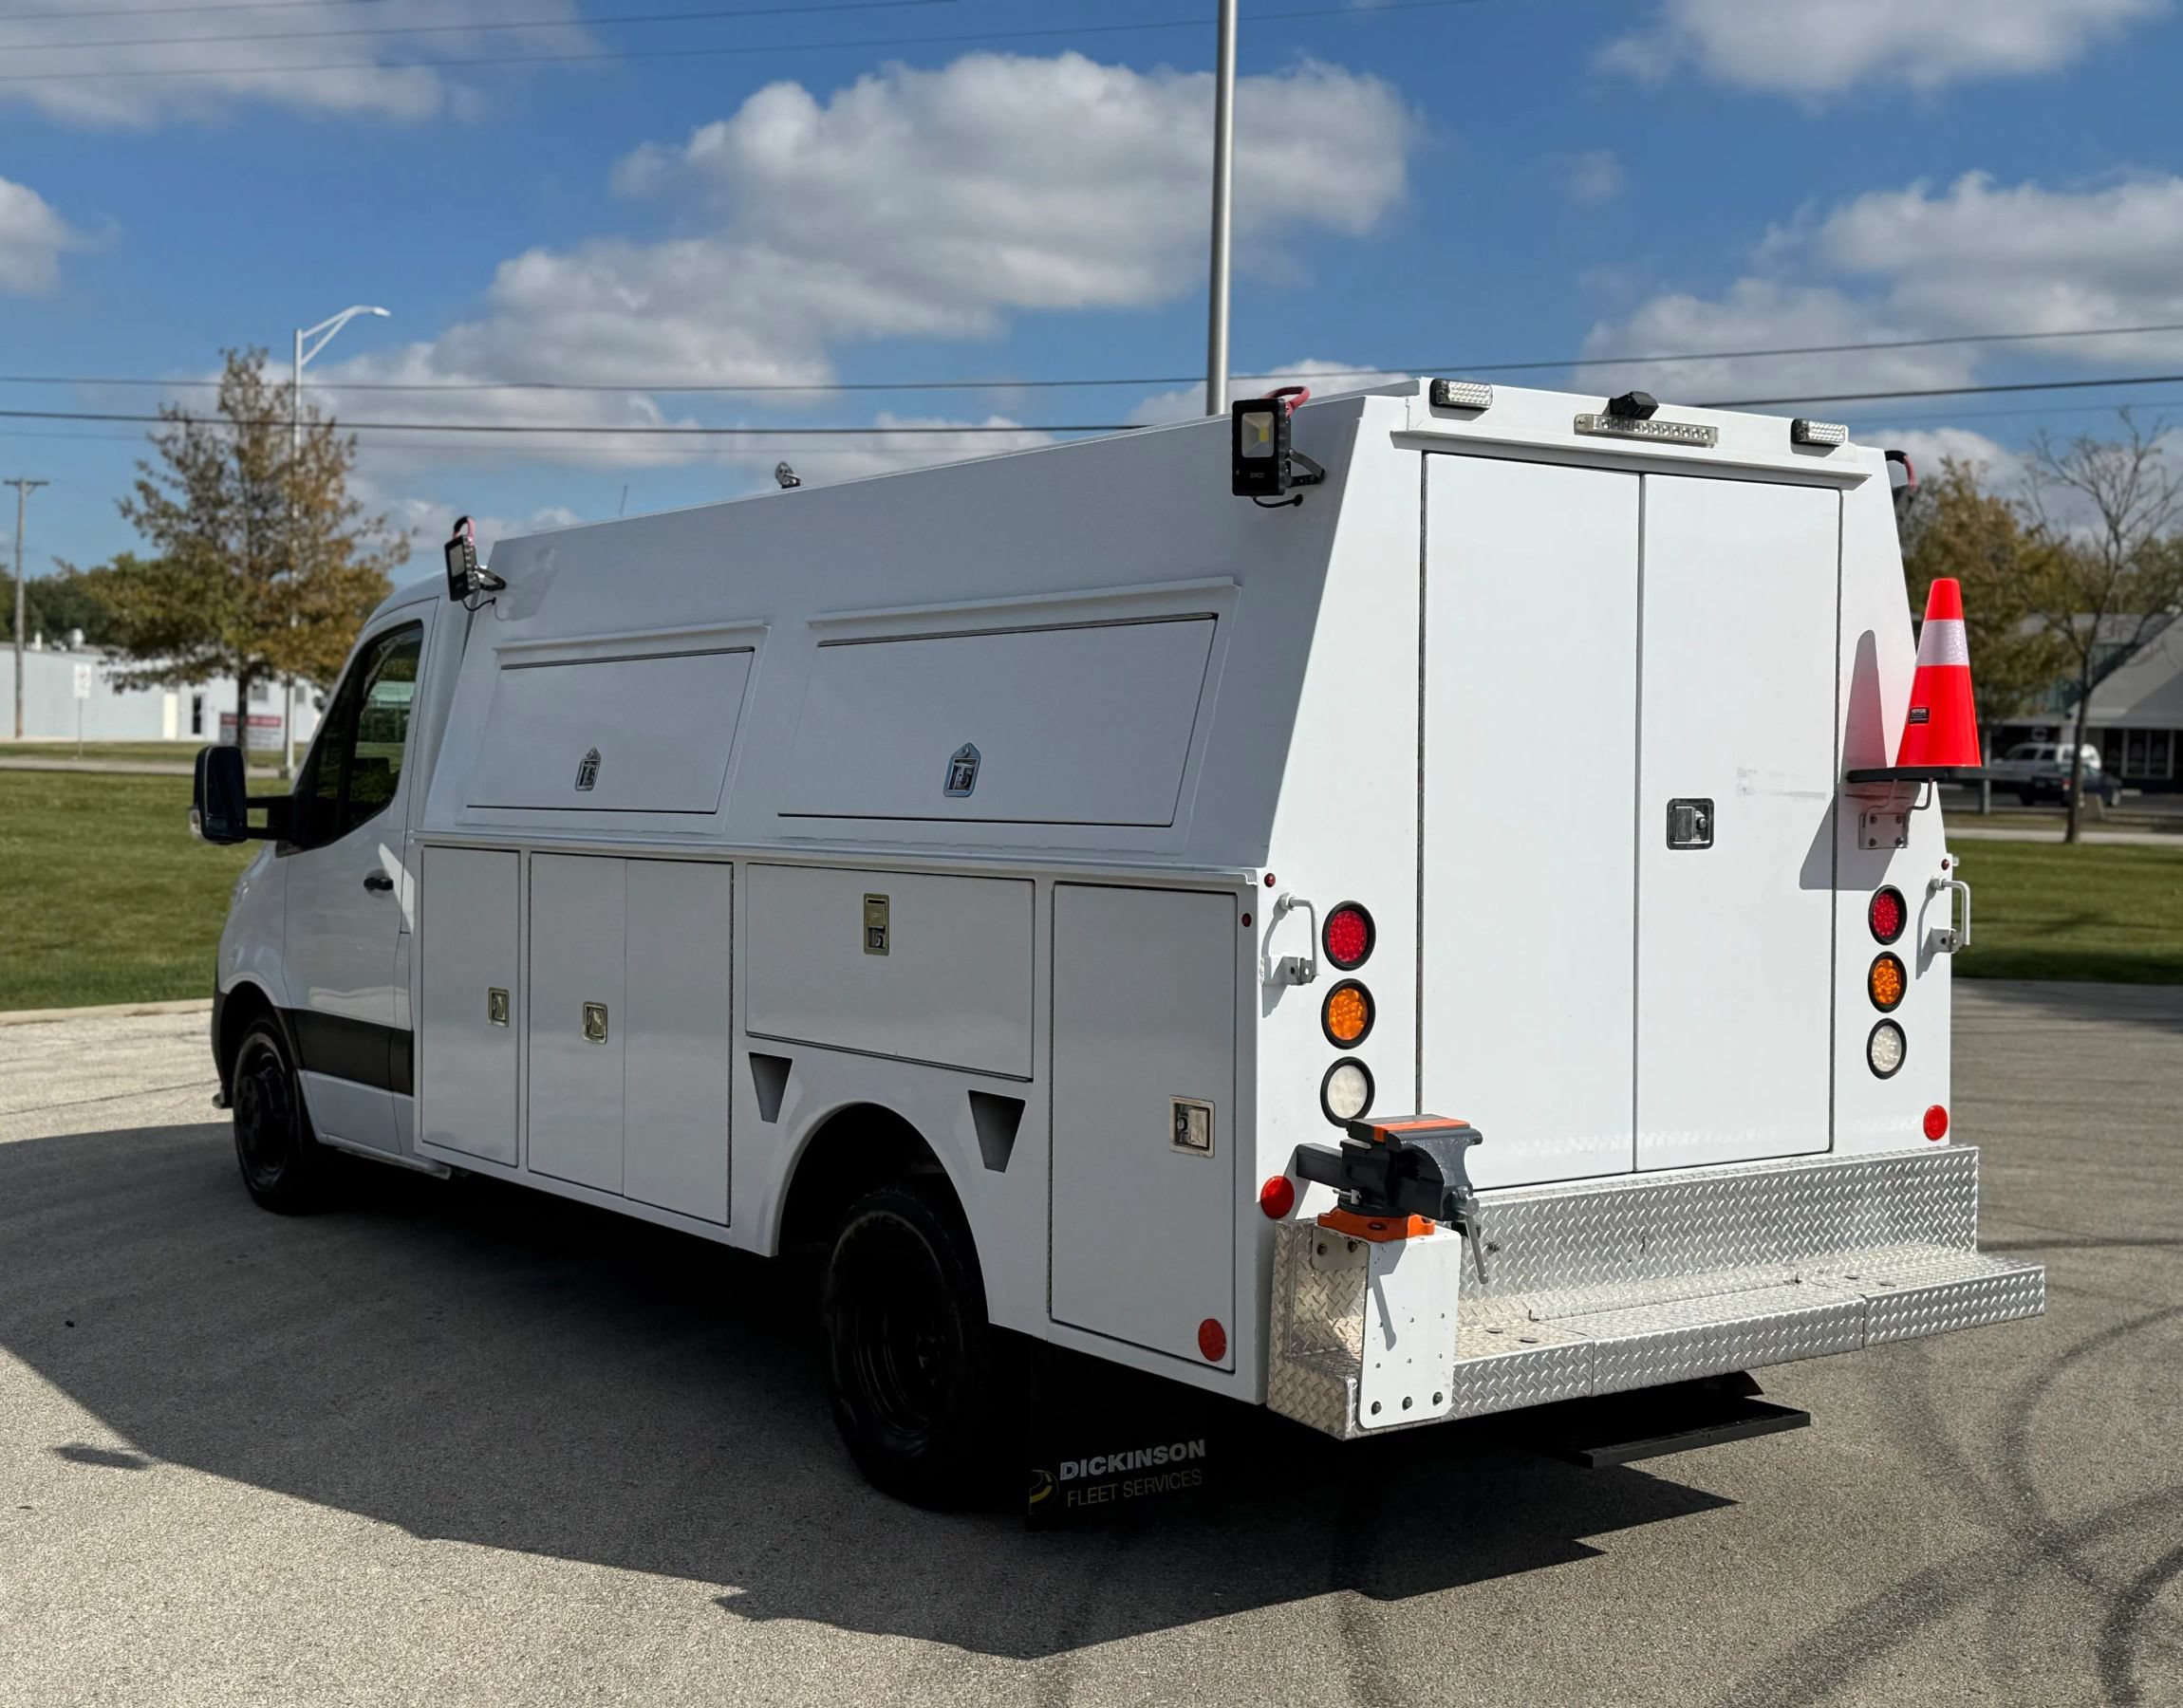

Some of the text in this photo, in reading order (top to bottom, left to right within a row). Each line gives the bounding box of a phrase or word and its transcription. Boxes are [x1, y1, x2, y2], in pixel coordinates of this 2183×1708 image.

[1059, 1439, 1205, 1480] DICKINSON
[1067, 1469, 1203, 1508] FLEET SERVICES
